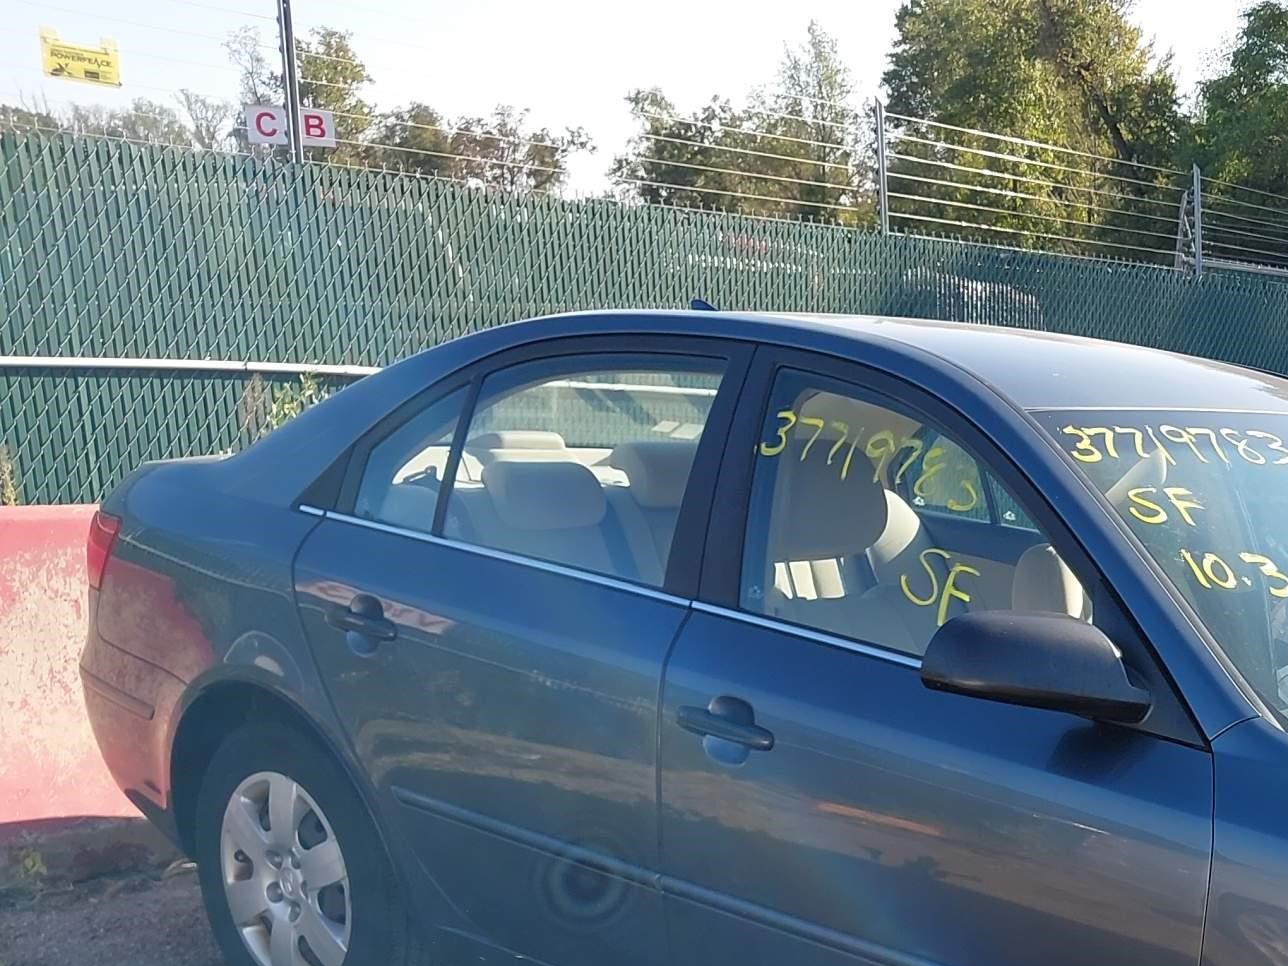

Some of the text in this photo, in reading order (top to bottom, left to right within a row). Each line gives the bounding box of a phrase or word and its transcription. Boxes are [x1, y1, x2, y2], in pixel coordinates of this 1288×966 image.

[256, 112, 326, 138] C B
[1127, 487, 1205, 526] SF
[902, 548, 981, 626] SF
